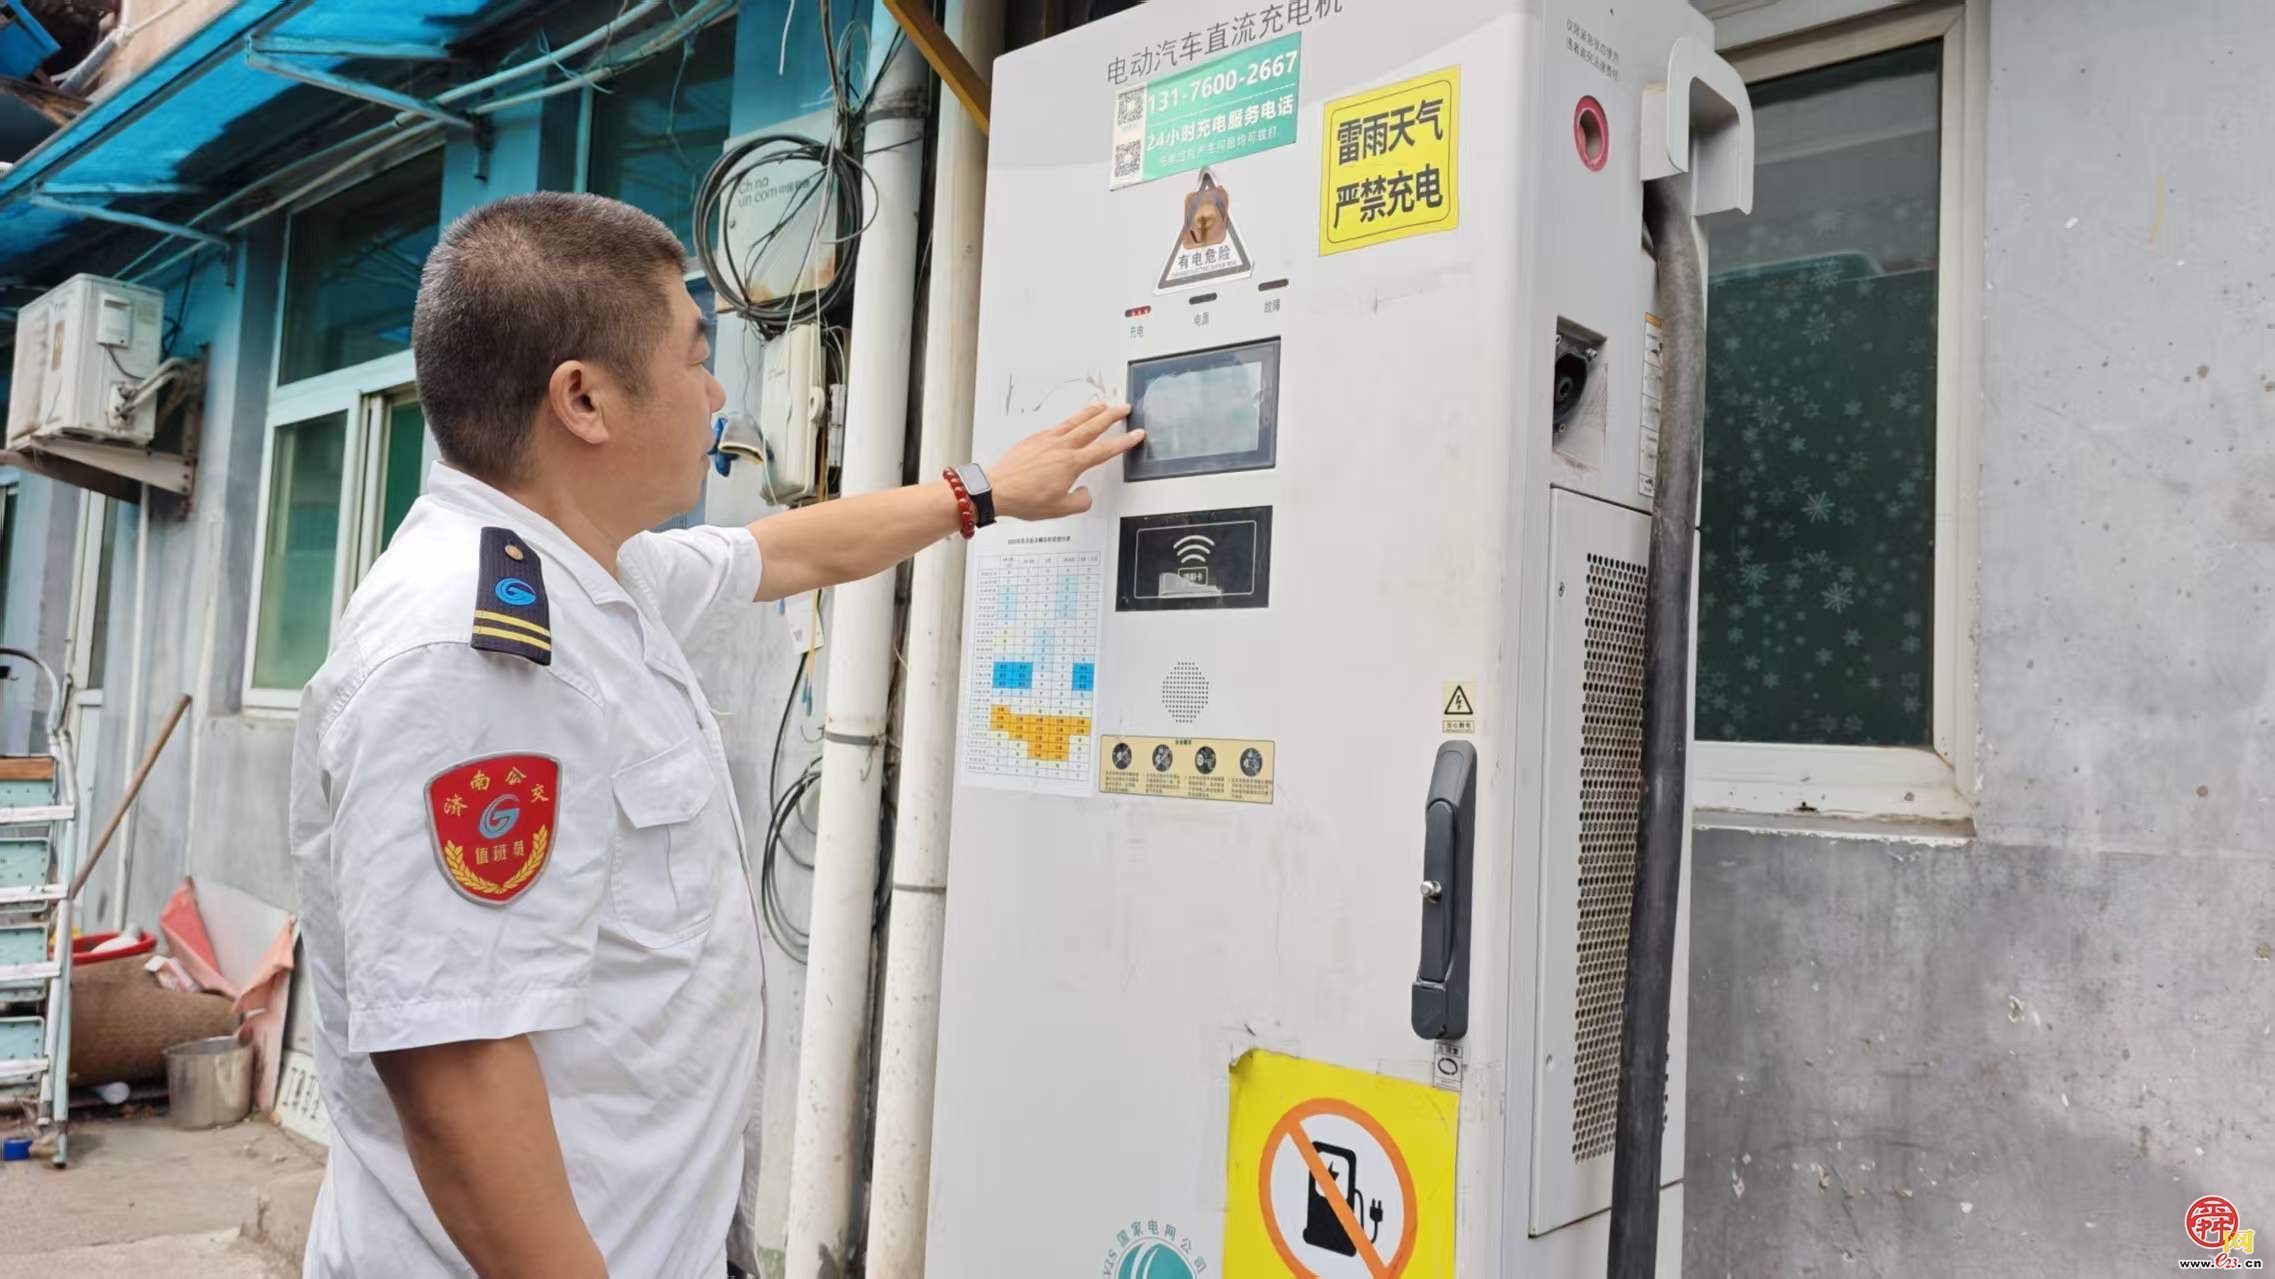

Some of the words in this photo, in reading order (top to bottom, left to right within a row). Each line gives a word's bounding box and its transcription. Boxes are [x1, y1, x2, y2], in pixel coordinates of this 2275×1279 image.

[1147, 50, 1298, 114] 131-7600-2667
[1146, 94, 1294, 151] 24小时充电服务电话
[1338, 98, 1443, 165] 雷雨天气
[1333, 163, 1443, 229] 严禁充电
[1178, 245, 1231, 269] 有电危险
[443, 766, 550, 817] 济南公交
[1116, 1218, 1208, 1274] 国家电网公司
